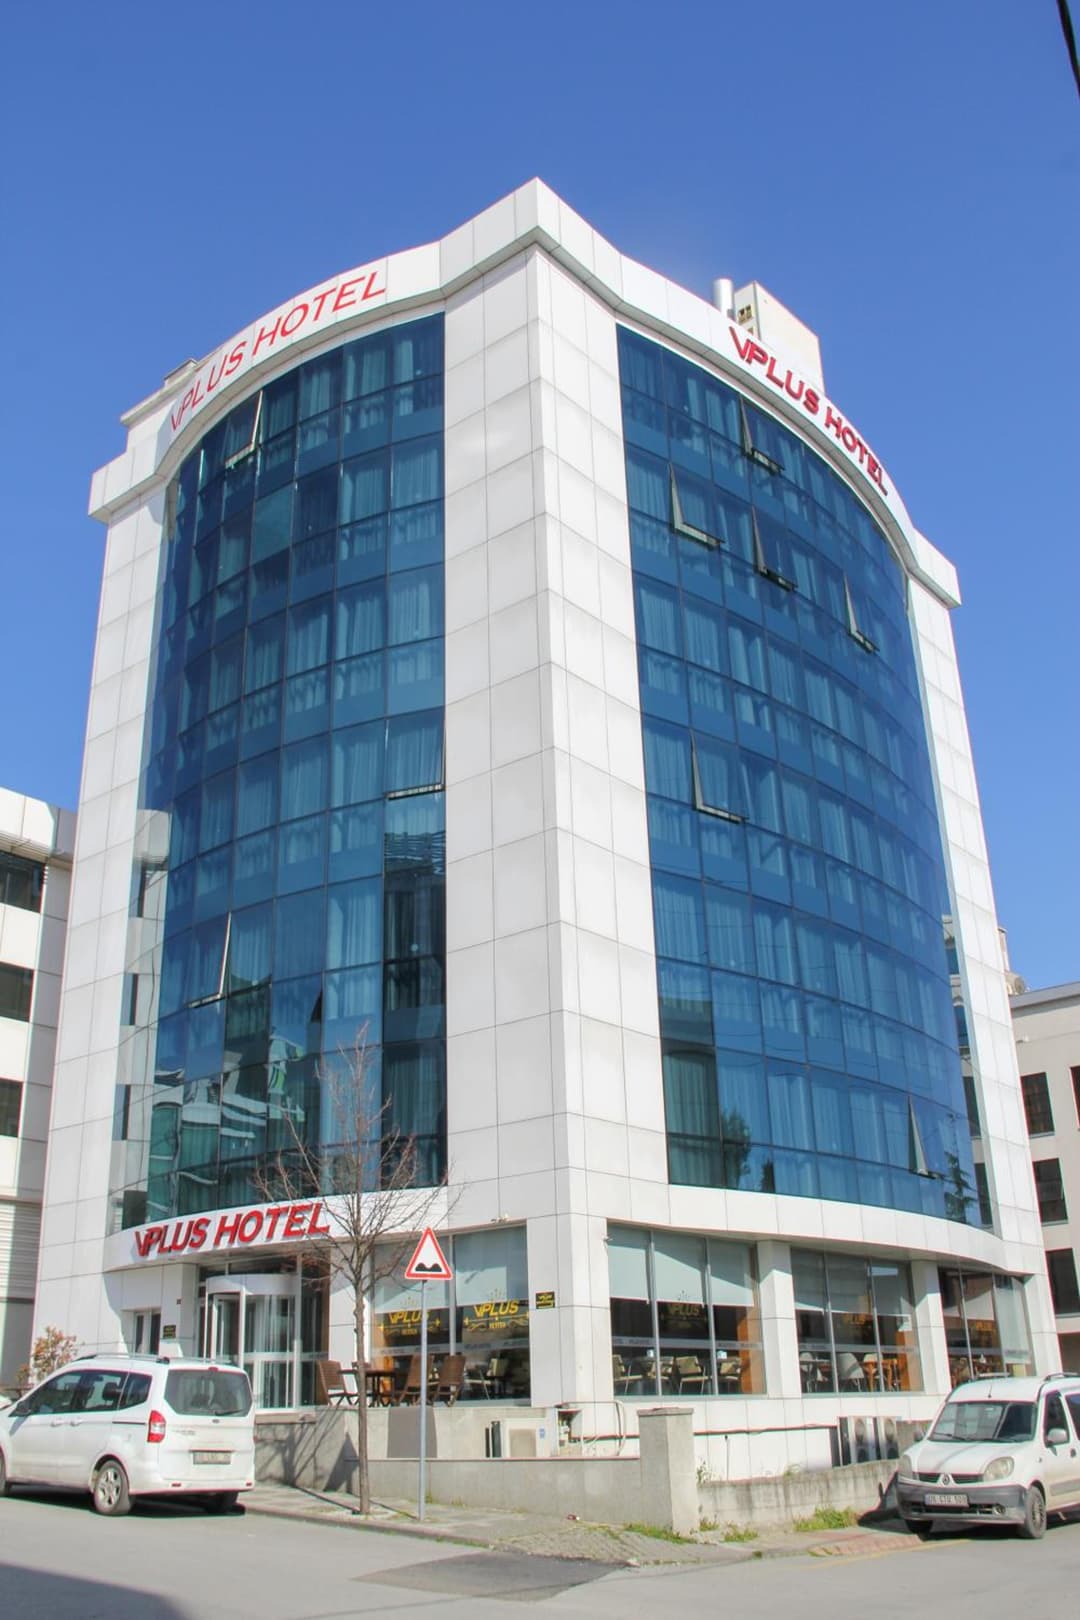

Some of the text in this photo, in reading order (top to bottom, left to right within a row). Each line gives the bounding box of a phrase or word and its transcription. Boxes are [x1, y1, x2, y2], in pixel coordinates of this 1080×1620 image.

[171, 271, 386, 431] VPLUS HOTEL
[728, 326, 889, 496] VPLUS HOTEL
[134, 1202, 330, 1257] VPLUS HOTEL
[473, 1300, 520, 1318] VPLUS
